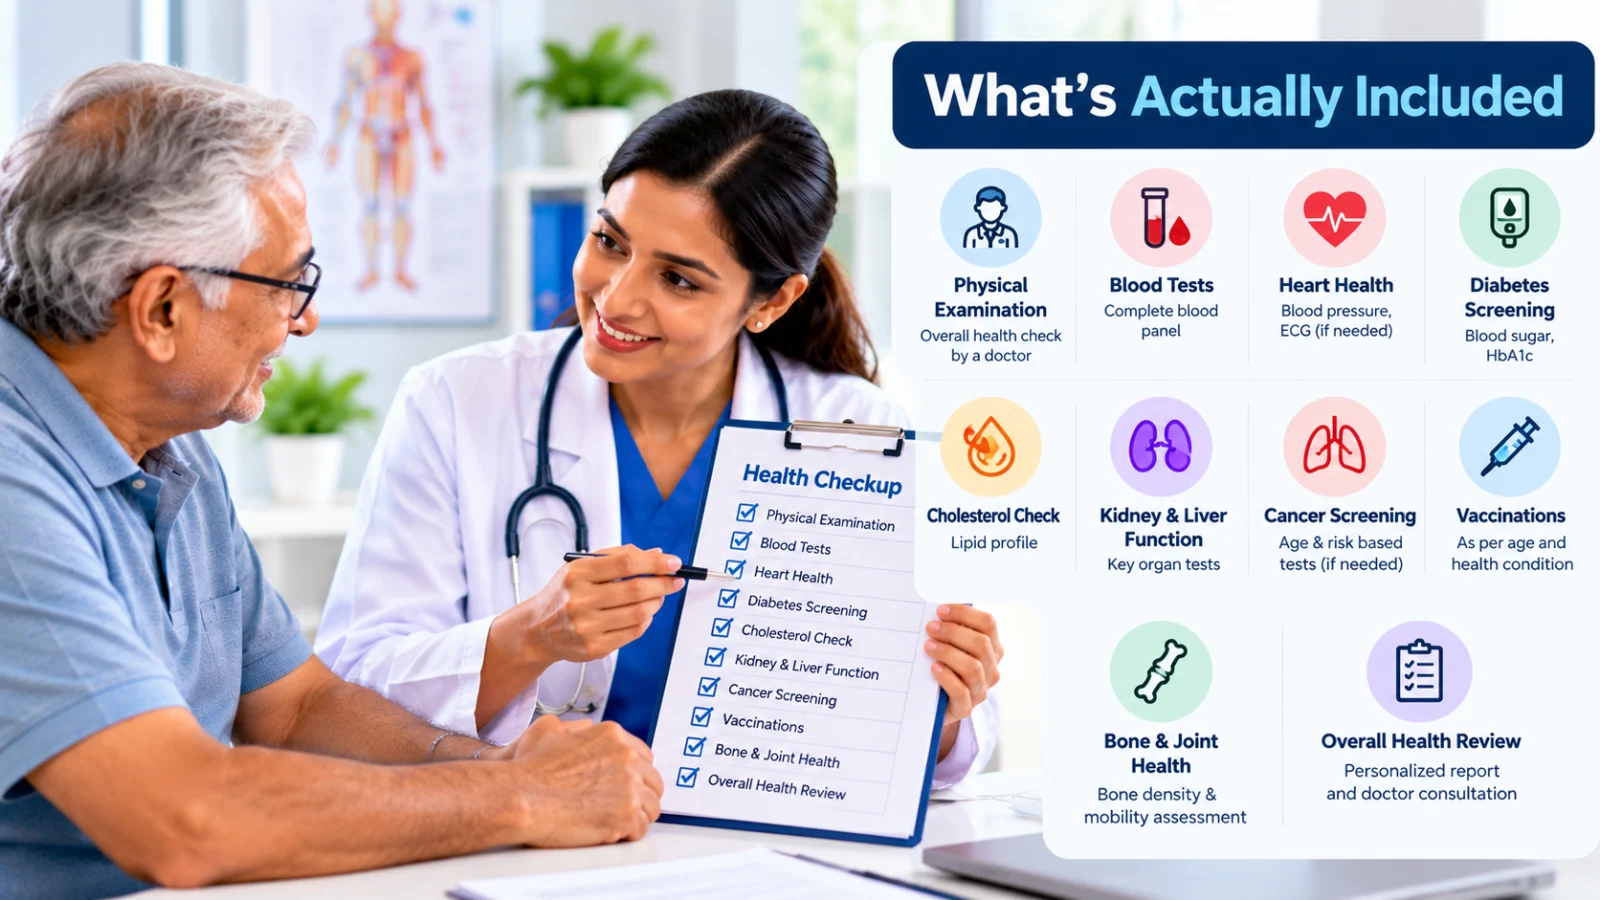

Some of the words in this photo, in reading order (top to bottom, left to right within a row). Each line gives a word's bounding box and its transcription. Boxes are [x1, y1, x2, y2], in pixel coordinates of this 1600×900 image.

[742, 463, 809, 487] Health
[813, 469, 903, 500] Checkup
[766, 508, 817, 525] Physical
[819, 513, 896, 533] Examination
[759, 536, 797, 552] Blood
[799, 540, 832, 556] Tests
[753, 565, 791, 581] Heart
[791, 569, 834, 585] Health
[747, 594, 803, 612] Diabetes
[805, 600, 868, 622] Screening
[741, 623, 812, 643] Cholesterol
[813, 631, 853, 648] Check
[734, 653, 778, 672] Kidney
[779, 658, 790, 671] &
[791, 659, 823, 675] Liver
[824, 663, 880, 681] Function
[728, 683, 773, 699] Cancer
[774, 688, 838, 710] Screening
[723, 713, 805, 734] Vaccinations
[714, 743, 749, 759] Bone
[750, 747, 761, 761] &
[763, 749, 796, 765] Joint
[798, 752, 841, 769] Health
[707, 773, 754, 791] Overall
[755, 779, 798, 795] Health
[800, 783, 847, 801] Review
